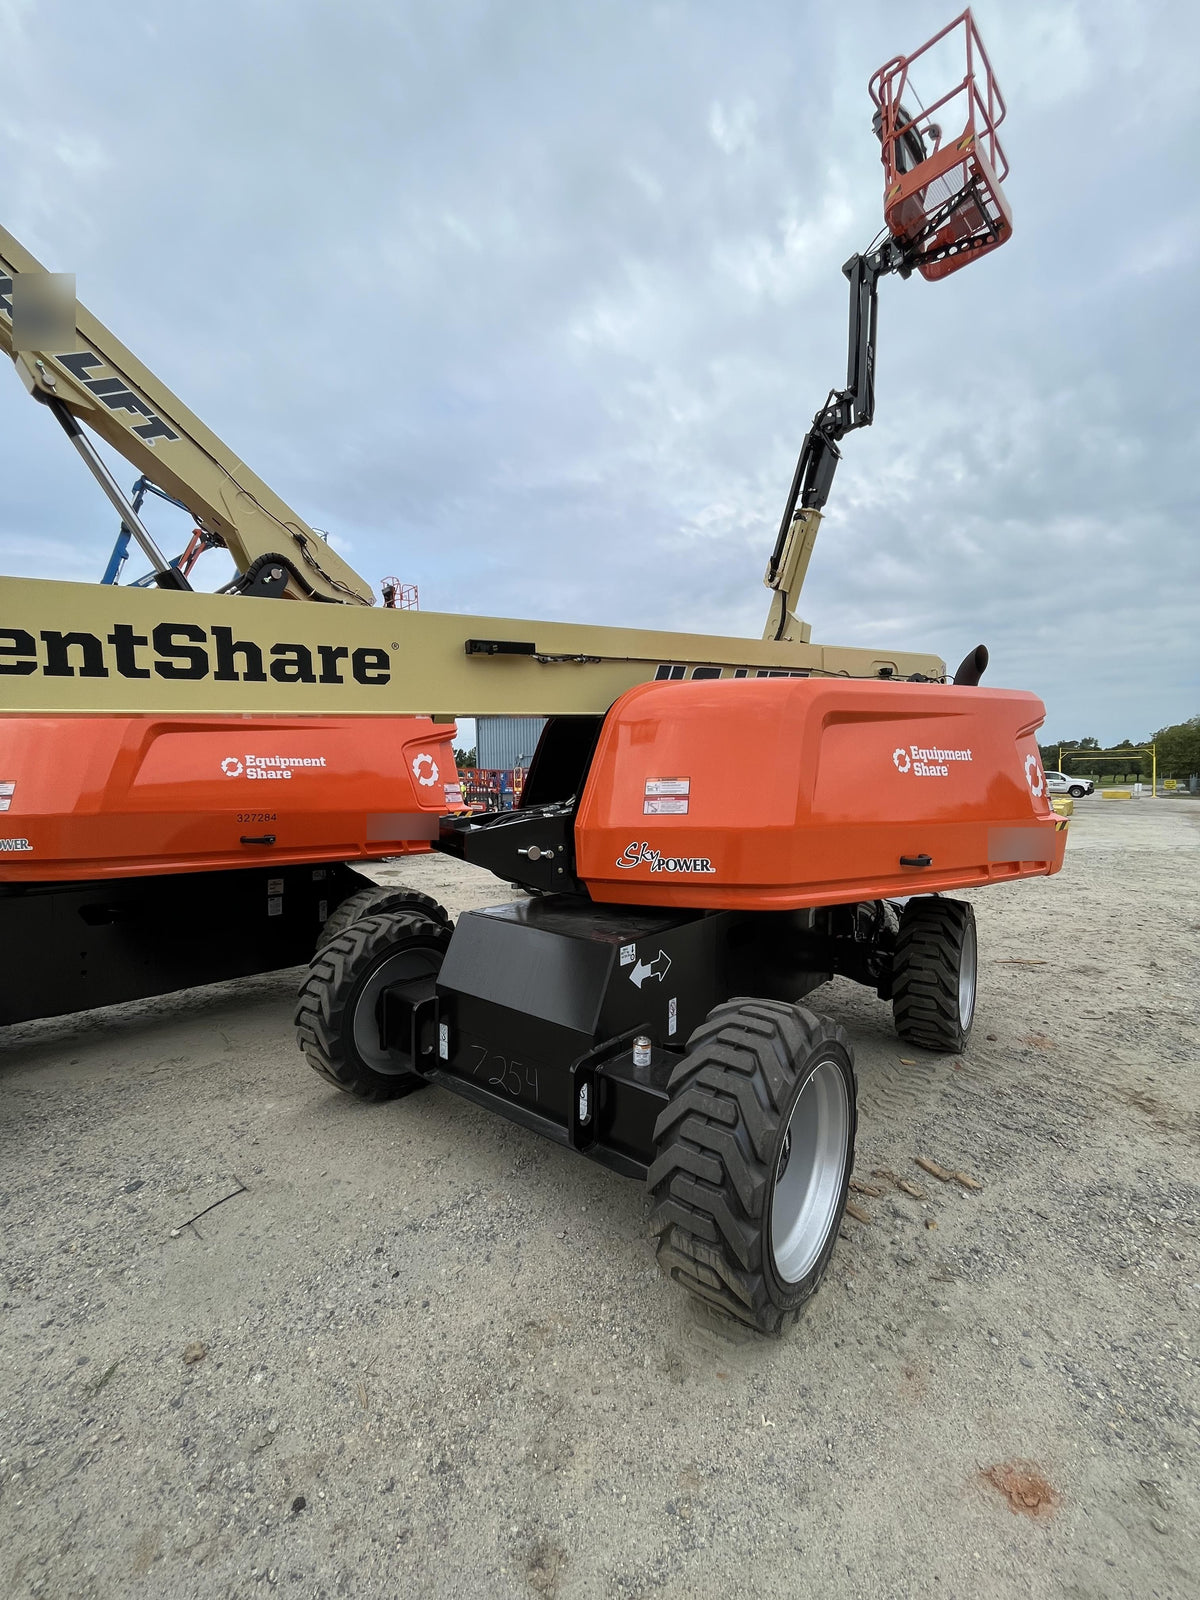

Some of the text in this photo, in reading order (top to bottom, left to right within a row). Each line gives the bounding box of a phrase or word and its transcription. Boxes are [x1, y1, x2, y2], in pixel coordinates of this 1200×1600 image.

[53, 351, 181, 441] LIFT
[909, 746, 972, 762] Equipment
[245, 755, 326, 768] Equipment
[246, 768, 294, 779] Share
[913, 762, 949, 776] Share
[237, 813, 277, 823] 327284
[471, 1045, 538, 1101] 7254
